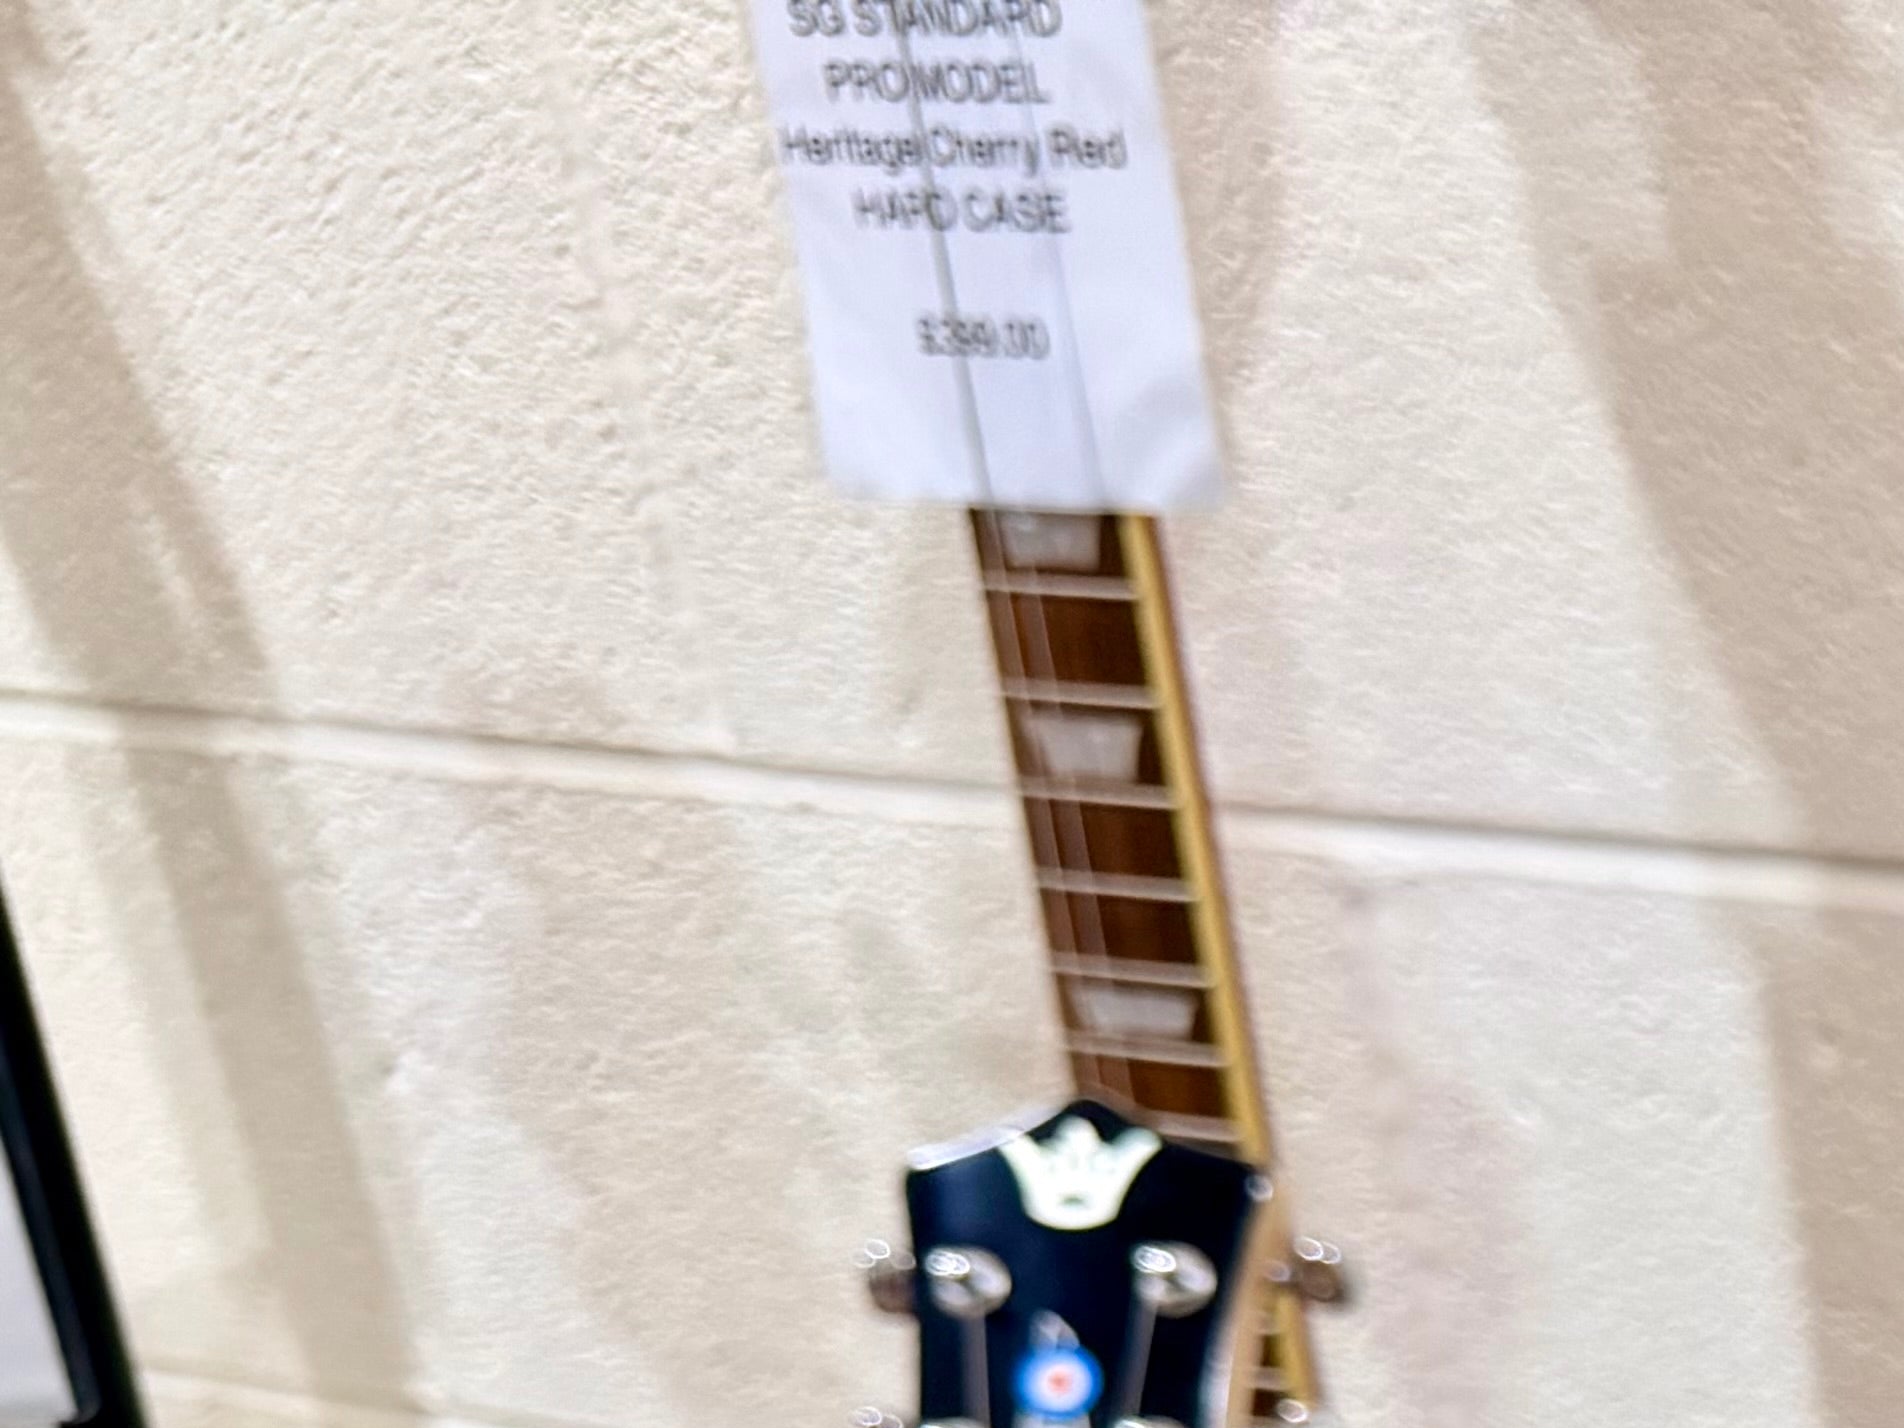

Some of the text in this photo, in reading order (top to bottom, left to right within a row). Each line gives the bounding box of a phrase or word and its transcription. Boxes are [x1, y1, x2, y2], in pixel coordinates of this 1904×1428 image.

[788, 0, 1062, 37] SG STANDARD
[823, 58, 1050, 104] PRO MODEL
[781, 122, 1127, 178] Heritage Cherry Red
[853, 186, 1073, 234] HARD CASE
